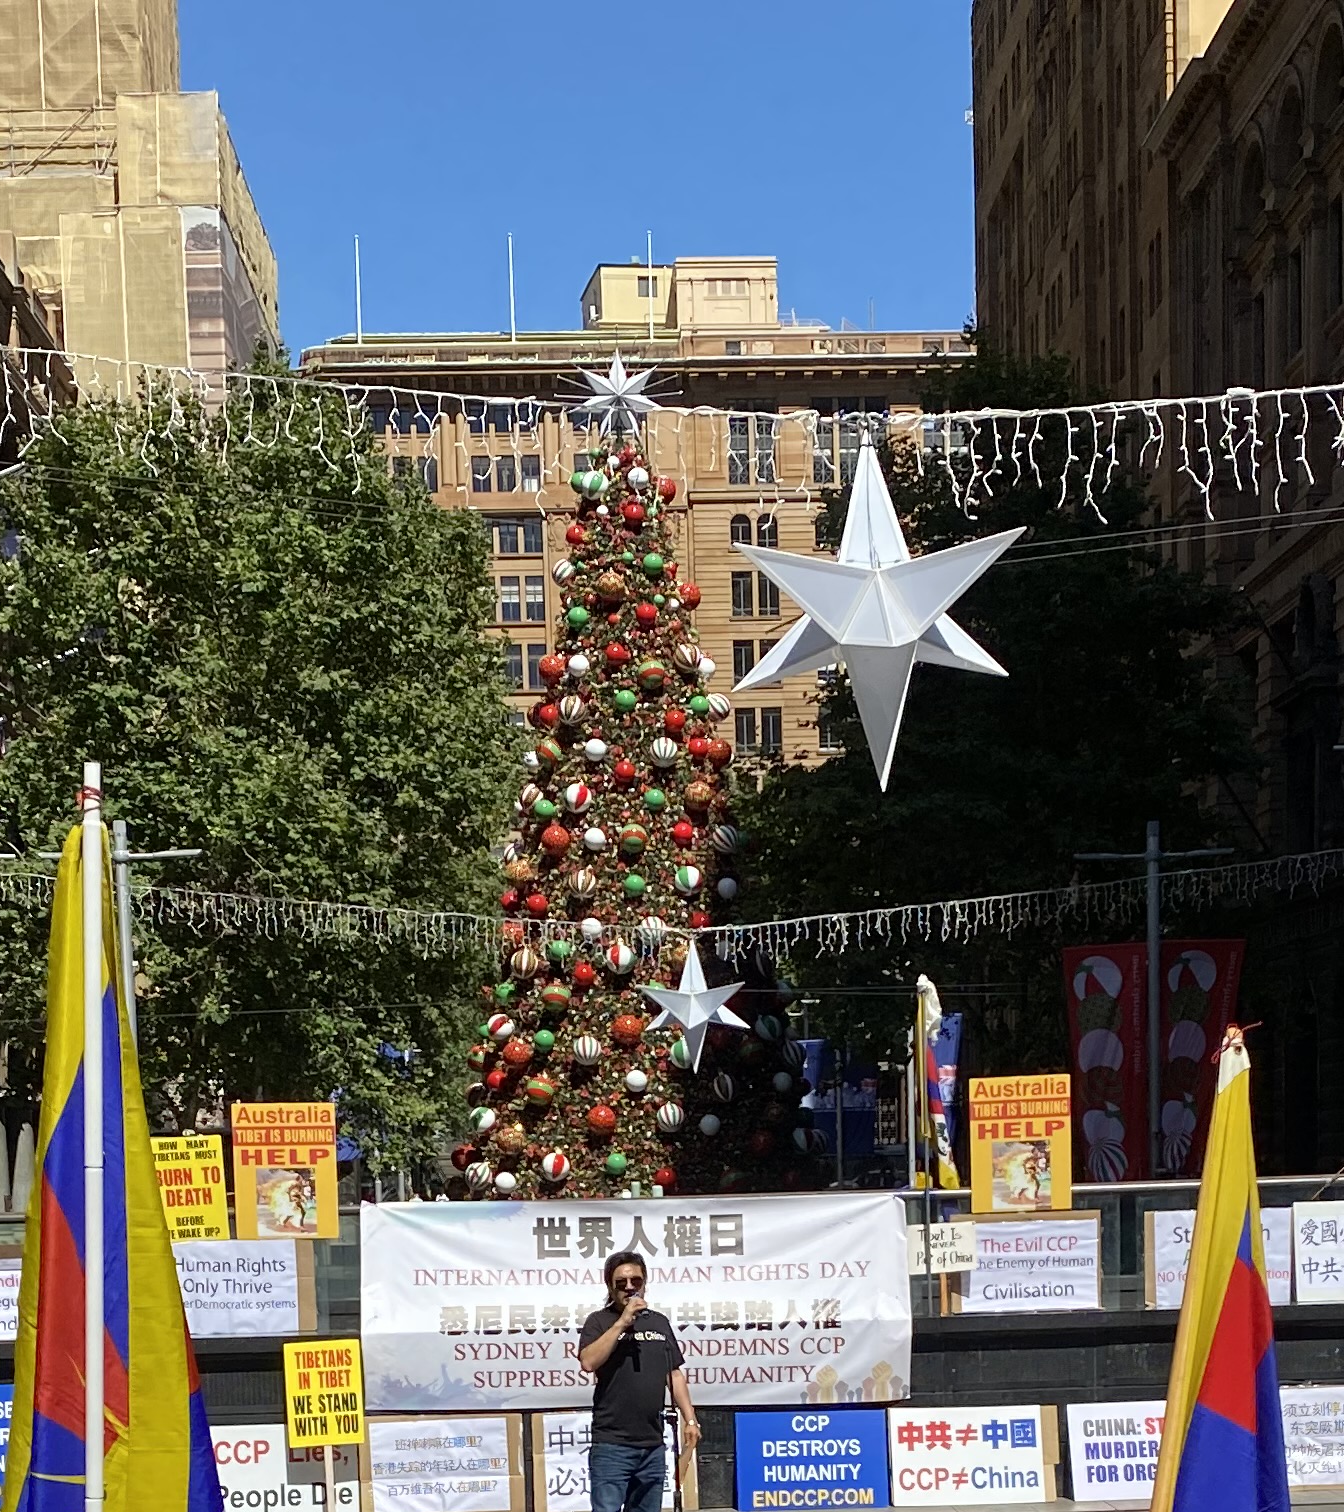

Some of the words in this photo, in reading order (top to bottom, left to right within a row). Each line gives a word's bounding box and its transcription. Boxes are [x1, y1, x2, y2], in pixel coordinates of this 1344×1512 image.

[974, 1077, 1067, 1098] Australia
[236, 1105, 331, 1124] Australia
[974, 1103, 1004, 1117] TIBET
[1007, 1102, 1017, 1115] IS
[1020, 1100, 1068, 1115] BURNING
[236, 1129, 266, 1143] TIBET
[270, 1128, 281, 1143] IS
[284, 1128, 333, 1143] BURNING
[978, 1120, 1065, 1139] HELP
[158, 1140, 178, 1151] HOW
[195, 1150, 217, 1160] MUST
[241, 1149, 330, 1166] HELP
[156, 1168, 193, 1187] BURN
[202, 1166, 220, 1184] TO
[166, 1188, 212, 1207] DEATH
[176, 1215, 205, 1226] BEFORE
[178, 1229, 201, 1239] WAKE
[205, 1227, 220, 1237] UP?
[532, 1214, 744, 1260] 世界人權日
[981, 1238, 1012, 1254] The
[1015, 1237, 1043, 1252] Evil
[1047, 1236, 1078, 1252] CCP
[175, 1257, 232, 1273] Human
[236, 1257, 286, 1277] Rights
[723, 1263, 810, 1282] RIGHTS
[820, 1260, 871, 1280] DAY
[996, 1257, 1036, 1271] Enemy
[1037, 1256, 1052, 1268] of
[1052, 1256, 1094, 1268] Human
[183, 1277, 219, 1298] Only
[222, 1278, 273, 1294] Thrive
[983, 1281, 1075, 1301] Civilisation
[195, 1299, 254, 1310] Democratic
[255, 1299, 297, 1312] systems
[294, 1348, 353, 1369] TIBETANS
[454, 1341, 551, 1361] SYDNEY
[799, 1337, 846, 1355] CCP
[298, 1371, 311, 1390] IN
[317, 1370, 351, 1388] TIBET
[685, 1365, 816, 1385] HUMANITY
[293, 1395, 313, 1415] WE
[318, 1392, 358, 1413] STAND
[294, 1415, 328, 1437] WITH
[335, 1414, 359, 1434] YOU
[792, 1415, 830, 1432] CCP
[1083, 1418, 1141, 1438] CHINA:
[214, 1440, 270, 1464] CCP
[762, 1438, 861, 1458] DESTROYS
[763, 1463, 861, 1483] HUMANITY
[1086, 1464, 1121, 1484] FOR
[752, 1488, 874, 1508] ENDCCP.COM
